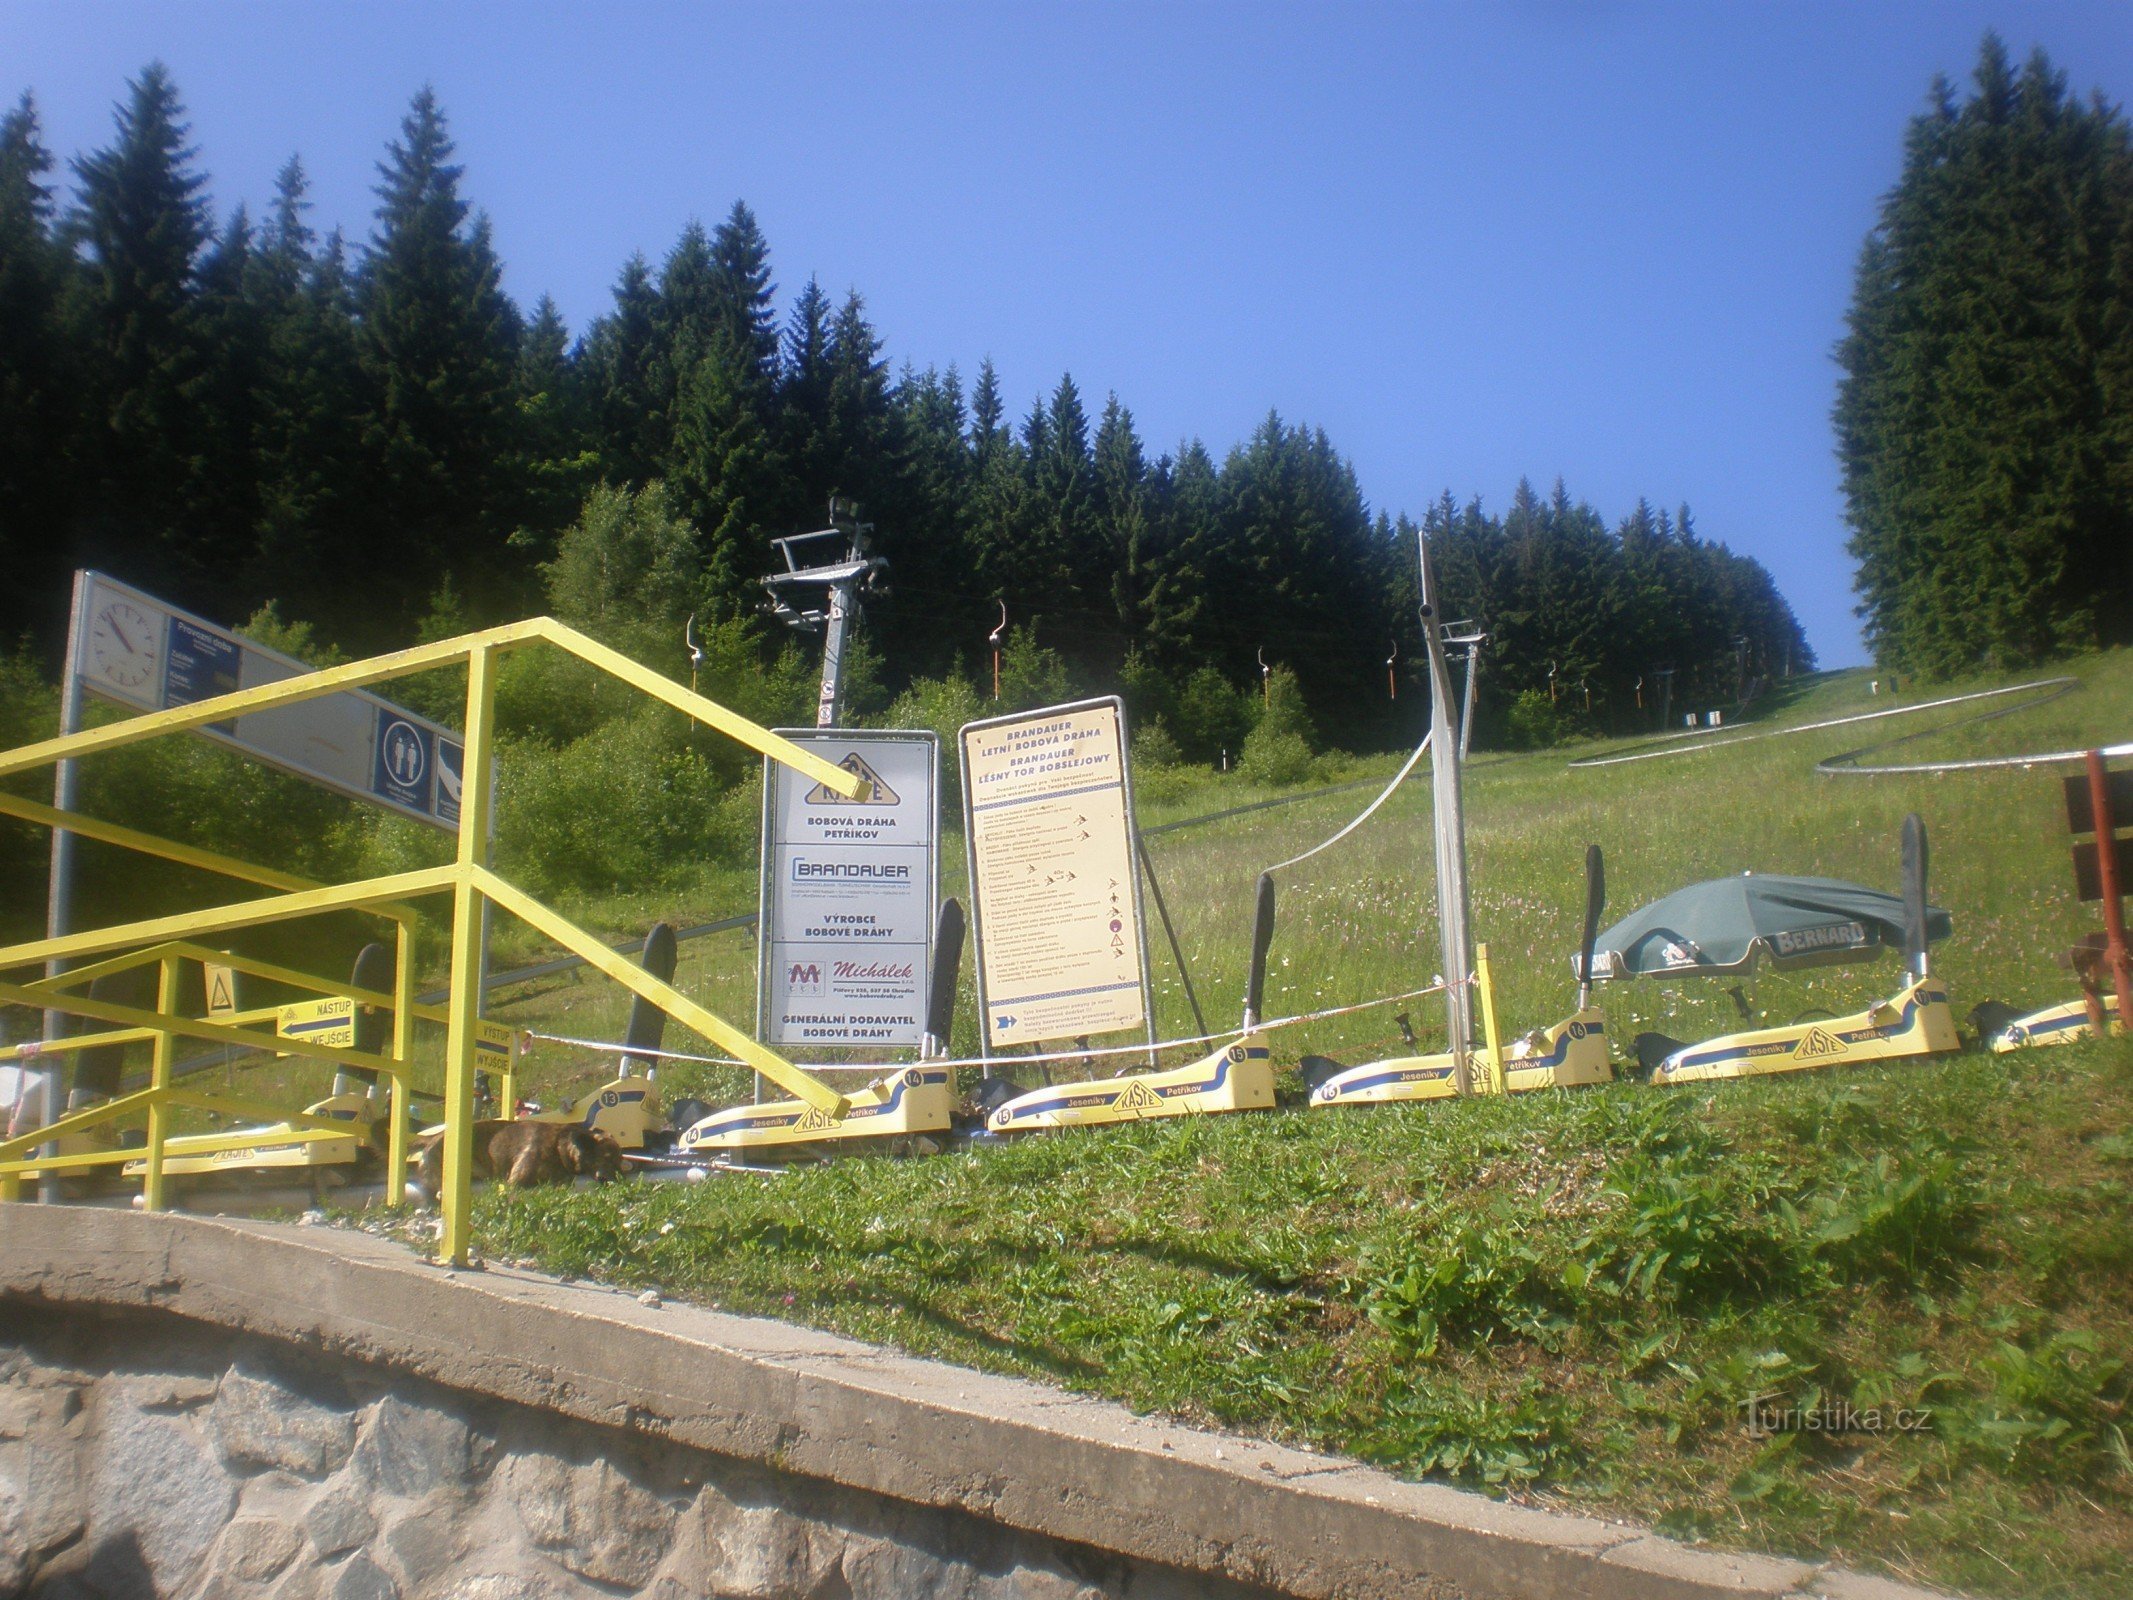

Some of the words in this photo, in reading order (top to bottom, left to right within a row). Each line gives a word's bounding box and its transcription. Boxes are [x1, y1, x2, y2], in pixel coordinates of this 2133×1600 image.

[1007, 721, 1072, 740] BRANDAUER
[982, 745, 1011, 757] LETNÍ
[1016, 734, 1059, 751] BOBOVÁ
[1064, 728, 1100, 742] DRÁHA
[1010, 748, 1075, 767] BRANDAUER
[1015, 767, 1034, 777] TOR
[1039, 754, 1111, 773] BOBSLEJOWY
[808, 816, 853, 826] BOBOVÁ
[858, 817, 896, 826] DRÁHA
[825, 829, 878, 839] PETŘÍKOV
[798, 864, 908, 877] BRANDAUER
[824, 913, 876, 924] VÝROBCE
[805, 926, 850, 936] BOBOVÉ
[854, 926, 894, 937] DRÁHY
[1777, 922, 1865, 954] BERNARD
[833, 961, 913, 978] Michálek
[317, 1000, 352, 1016] NÁSTUP
[782, 1013, 846, 1024] GENERÁLNÍ
[850, 1016, 916, 1024] DODAVATEL
[803, 1027, 849, 1037] BOBOVÉ
[853, 1027, 893, 1037] DRÁHY
[1572, 1025, 1584, 1036] 16
[1802, 1030, 1838, 1056] KASTE
[1230, 1049, 1243, 1059] 15
[907, 1073, 919, 1084] 14
[604, 1093, 616, 1104] 13
[1068, 1096, 1106, 1108] Jeseníky
[1122, 1084, 1154, 1108] KASTE
[1167, 1085, 1202, 1096] Petříkov
[1324, 1087, 1336, 1098] 16
[752, 1118, 788, 1128] Jeseníky
[846, 1108, 879, 1118] Petříkov
[998, 1109, 1009, 1123] 15
[686, 1129, 697, 1142] 14
